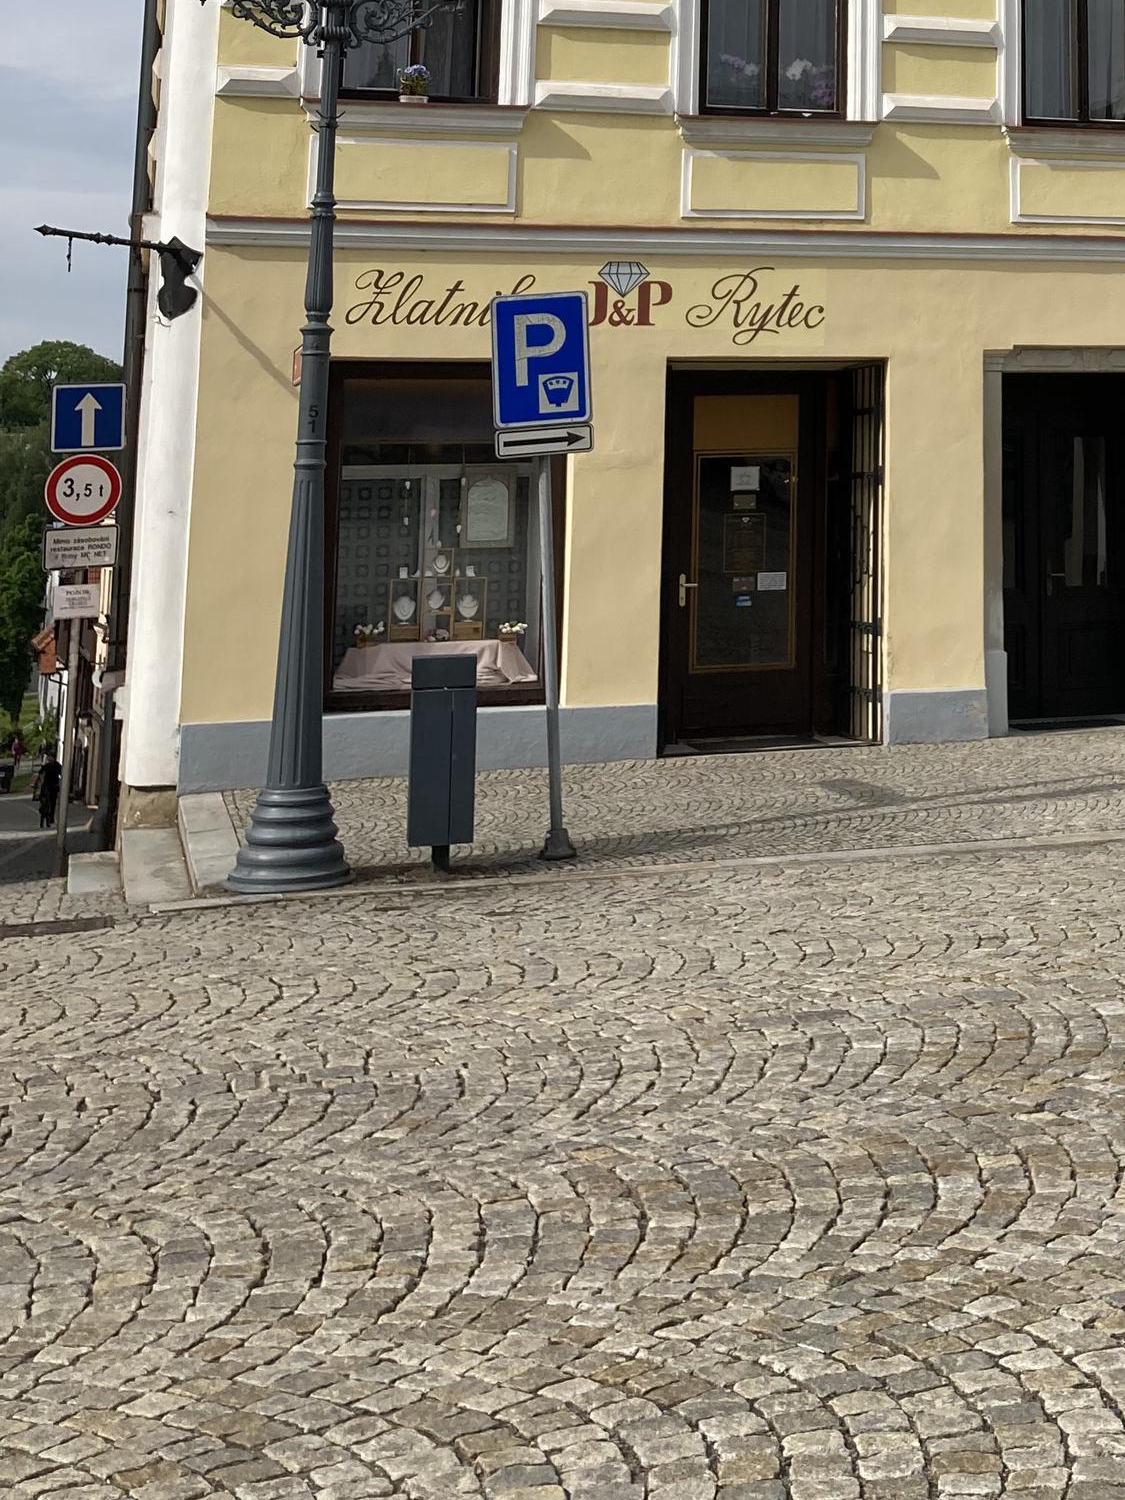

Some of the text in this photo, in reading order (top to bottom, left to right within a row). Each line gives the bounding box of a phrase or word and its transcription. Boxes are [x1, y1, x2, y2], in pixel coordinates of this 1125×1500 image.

[588, 280, 673, 327] J&P
[685, 266, 825, 346] Rytec
[513, 312, 567, 387] P
[62, 477, 104, 501] 3,5 t
[87, 542, 112, 550] RONDO
